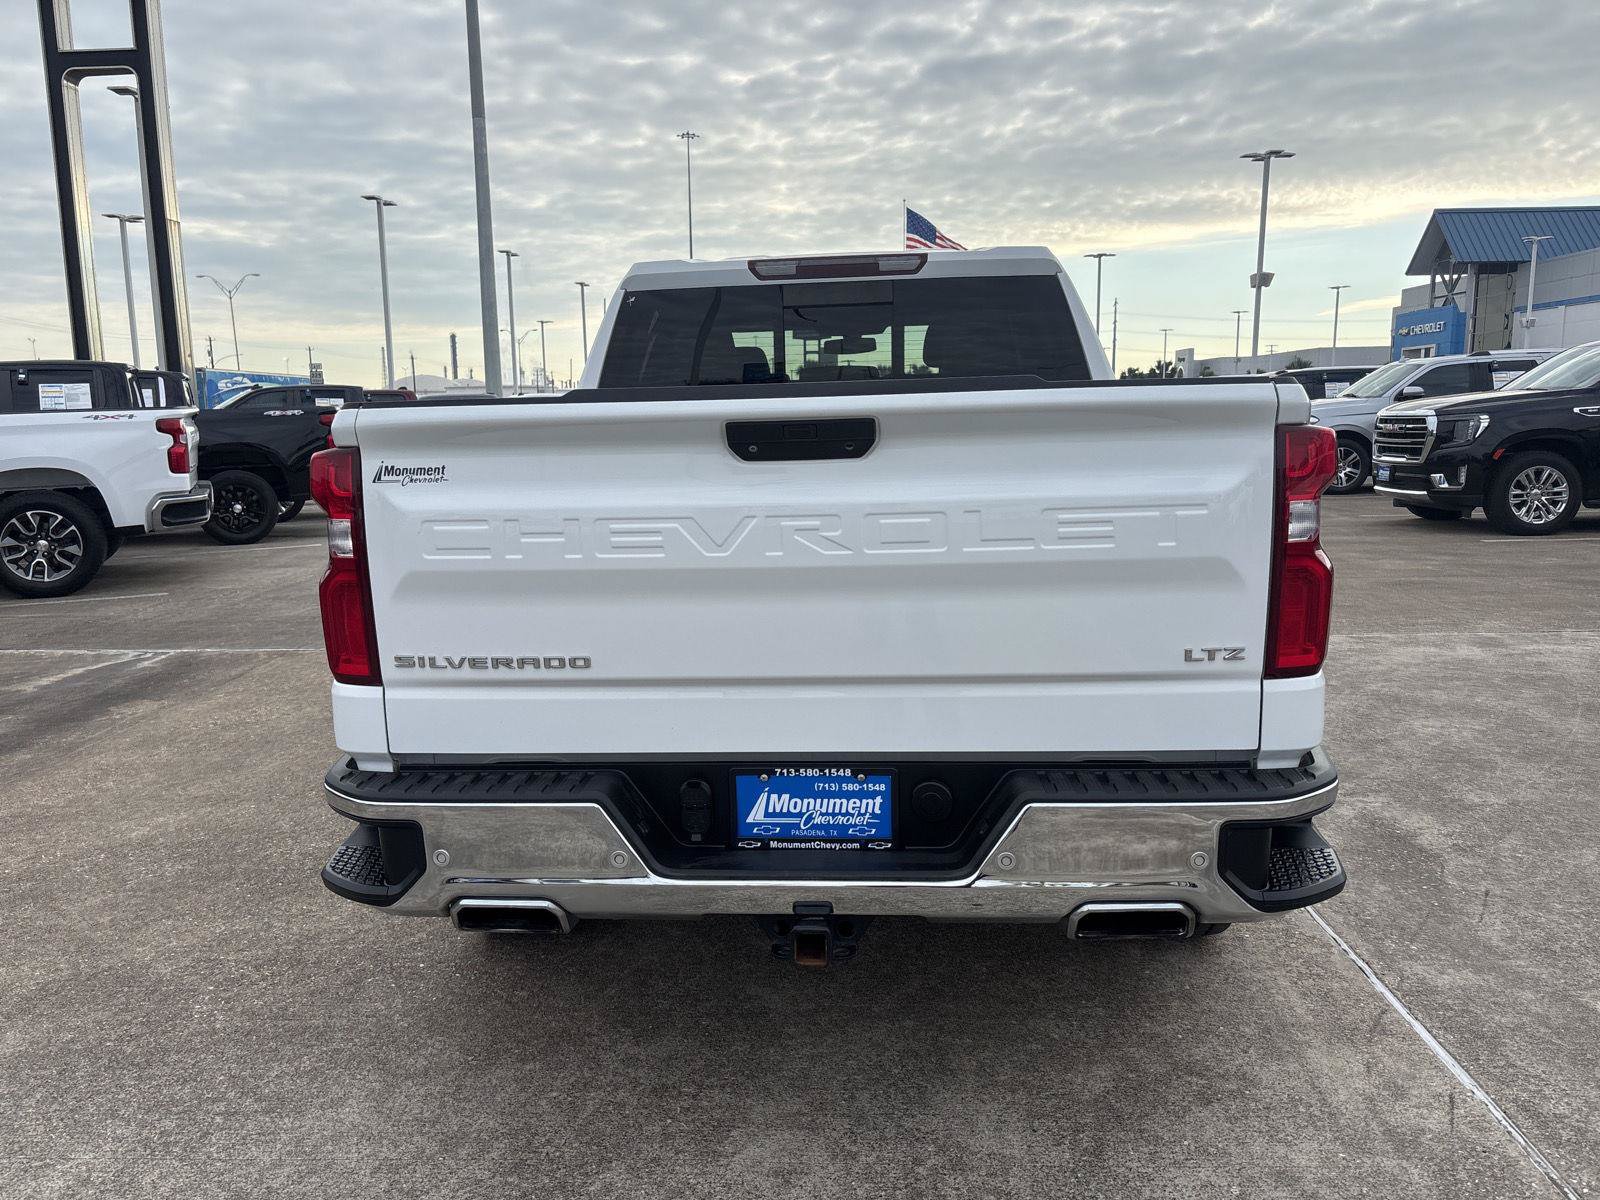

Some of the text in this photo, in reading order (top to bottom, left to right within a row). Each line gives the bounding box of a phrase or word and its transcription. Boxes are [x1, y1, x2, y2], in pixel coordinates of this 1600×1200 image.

[1410, 321, 1445, 335] CHEVROLET
[383, 464, 446, 477] Monument
[401, 474, 449, 487] Chevrolet
[420, 503, 1209, 560] CHEVROLET
[1184, 647, 1246, 662] LTZ
[394, 655, 592, 670] SILVERADO
[774, 768, 852, 777] 713-580-1548
[814, 782, 886, 792] (713) 580-1548
[768, 793, 883, 814] Monument
[800, 810, 881, 830] Chevrolet
[769, 840, 860, 850] MonumentChevy.com
